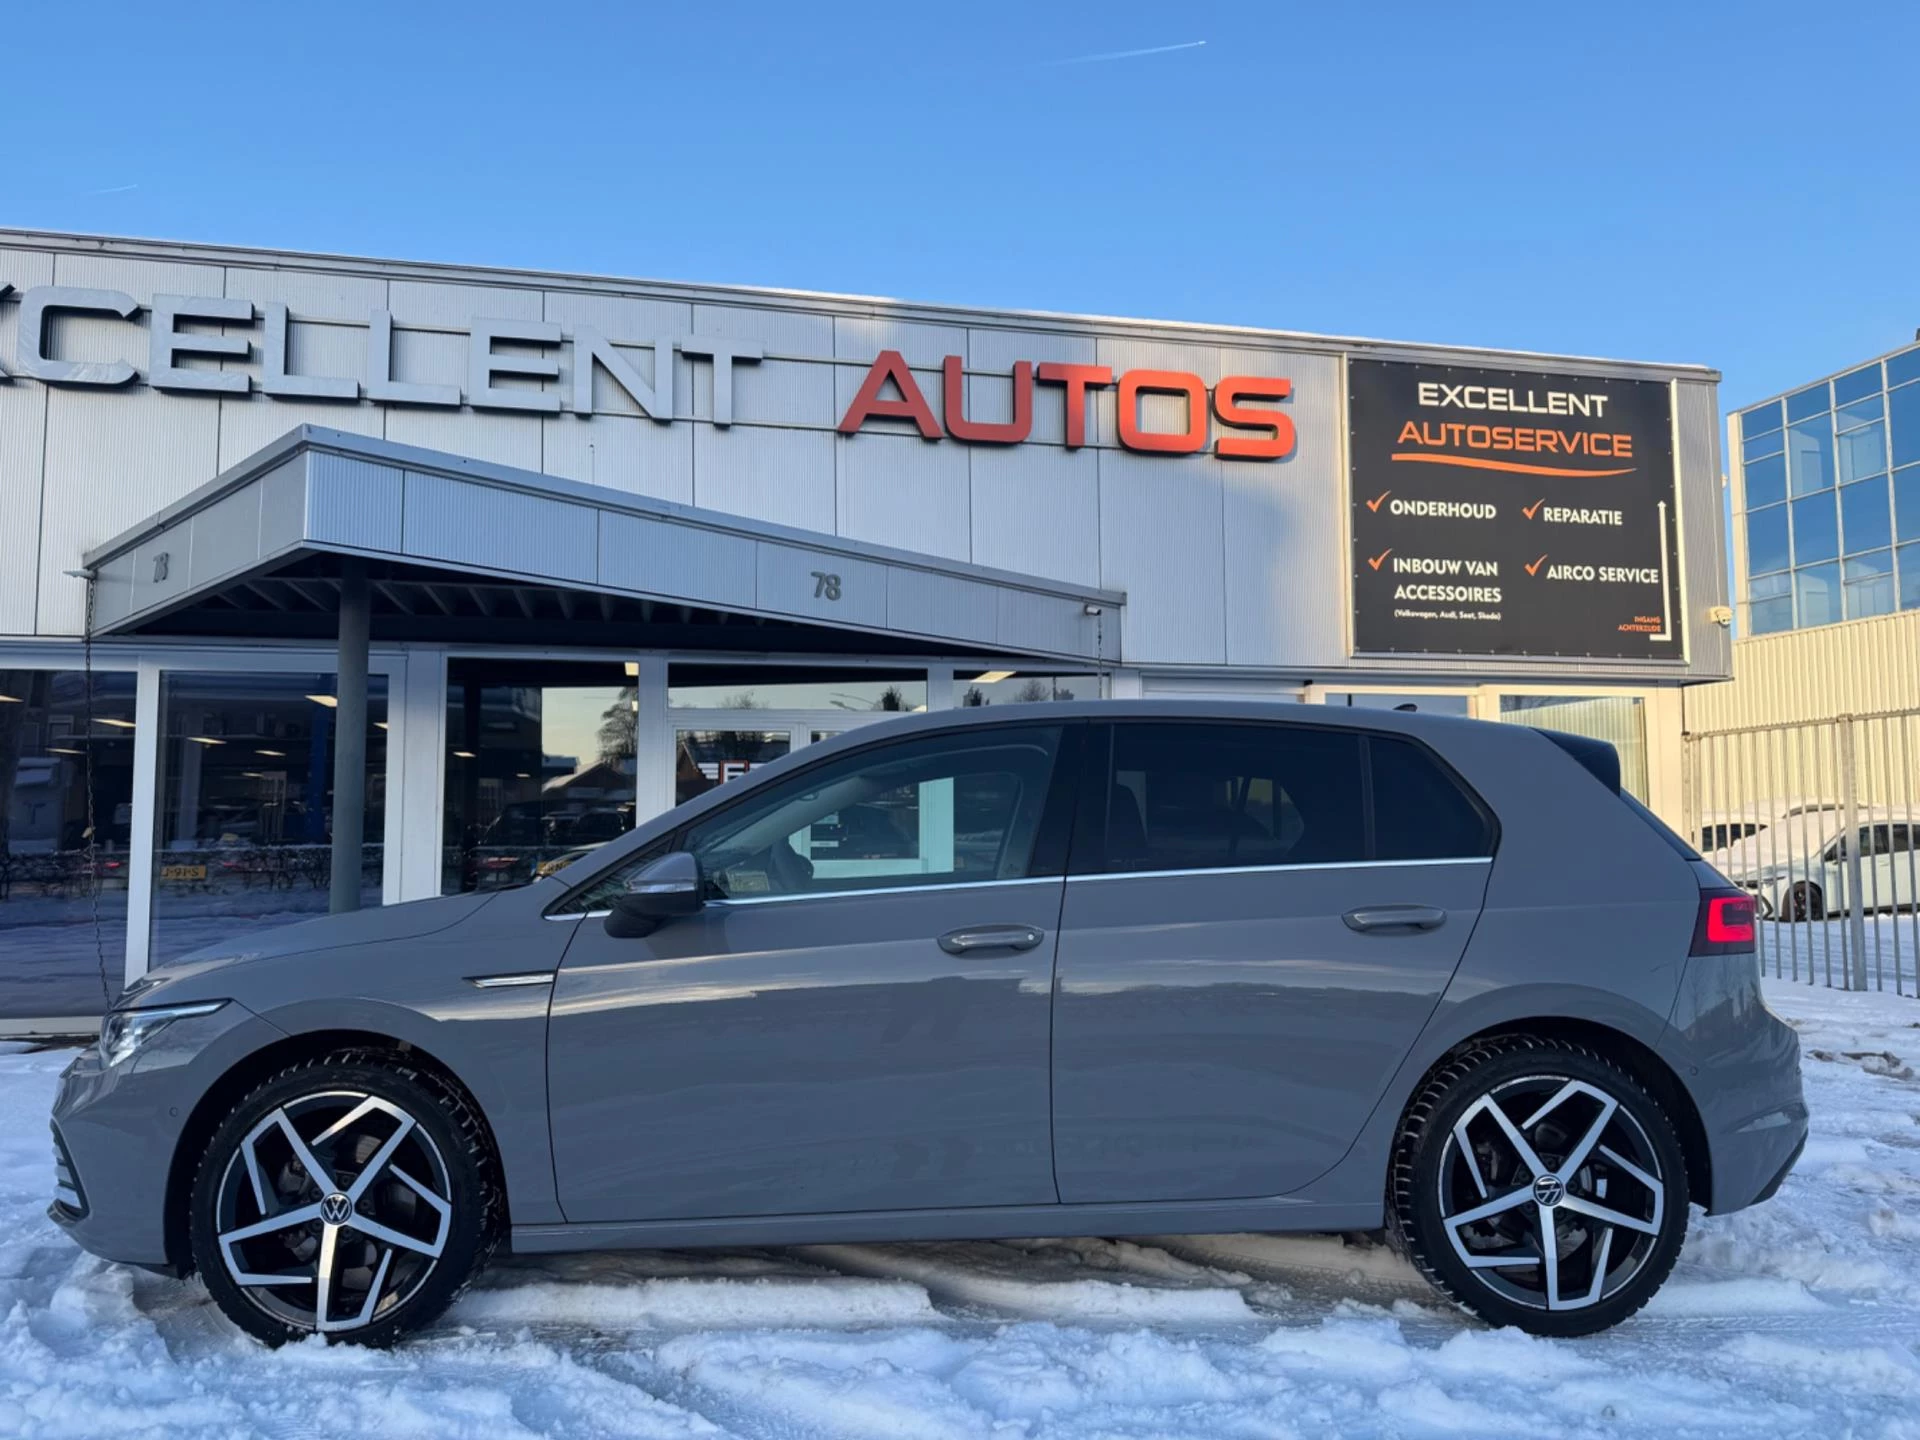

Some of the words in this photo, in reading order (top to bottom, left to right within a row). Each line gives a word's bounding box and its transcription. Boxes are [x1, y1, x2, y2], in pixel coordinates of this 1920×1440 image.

[0, 283, 764, 428] CELLENT
[837, 350, 1297, 460] AUTOS
[1418, 382, 1608, 417] EXCELLENT
[1397, 421, 1633, 457] AUTOSERVICE
[1390, 499, 1497, 519] ONDERHOUD
[1543, 506, 1622, 525] REPARATIE
[1393, 558, 1463, 575] INBOUW
[1465, 561, 1498, 577] VAN
[1547, 565, 1595, 581] AIRCO
[1598, 567, 1659, 584] SERVICE
[811, 571, 841, 601] 78
[1394, 584, 1502, 603] ACCESSOIRES
